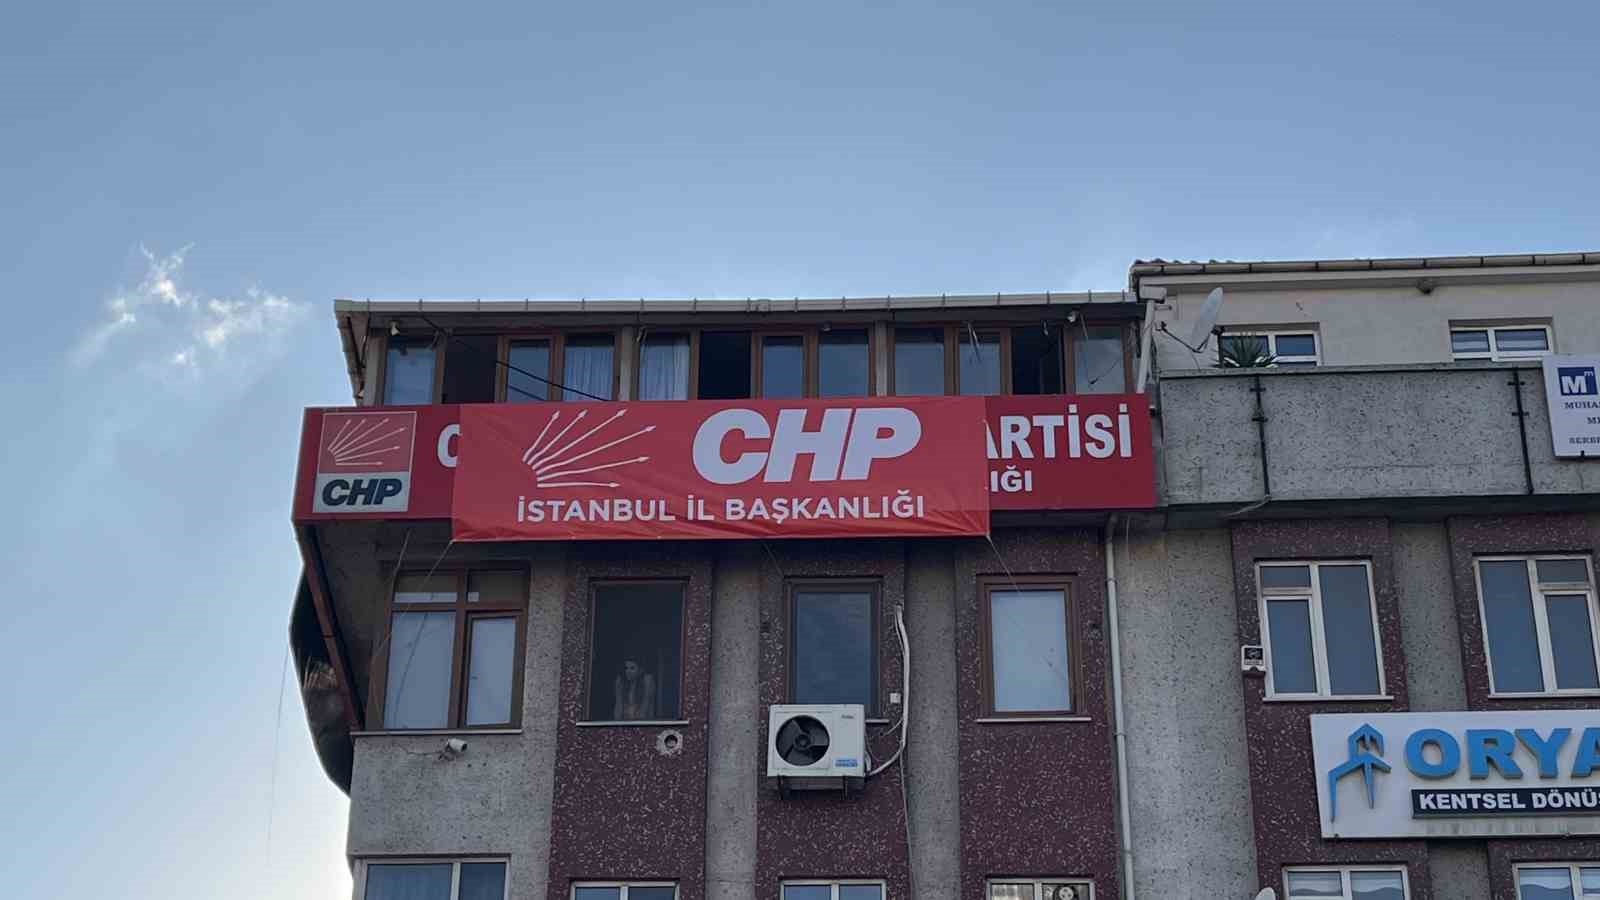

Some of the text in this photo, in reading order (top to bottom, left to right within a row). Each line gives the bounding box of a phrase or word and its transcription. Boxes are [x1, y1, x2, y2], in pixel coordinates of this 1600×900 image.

[692, 408, 922, 485] CHP
[321, 478, 402, 506] CHP
[517, 489, 924, 524] İSTANBUL İL BAŞKANLIĞI
[1419, 788, 1600, 810] KENTSEL DÖNÜ
